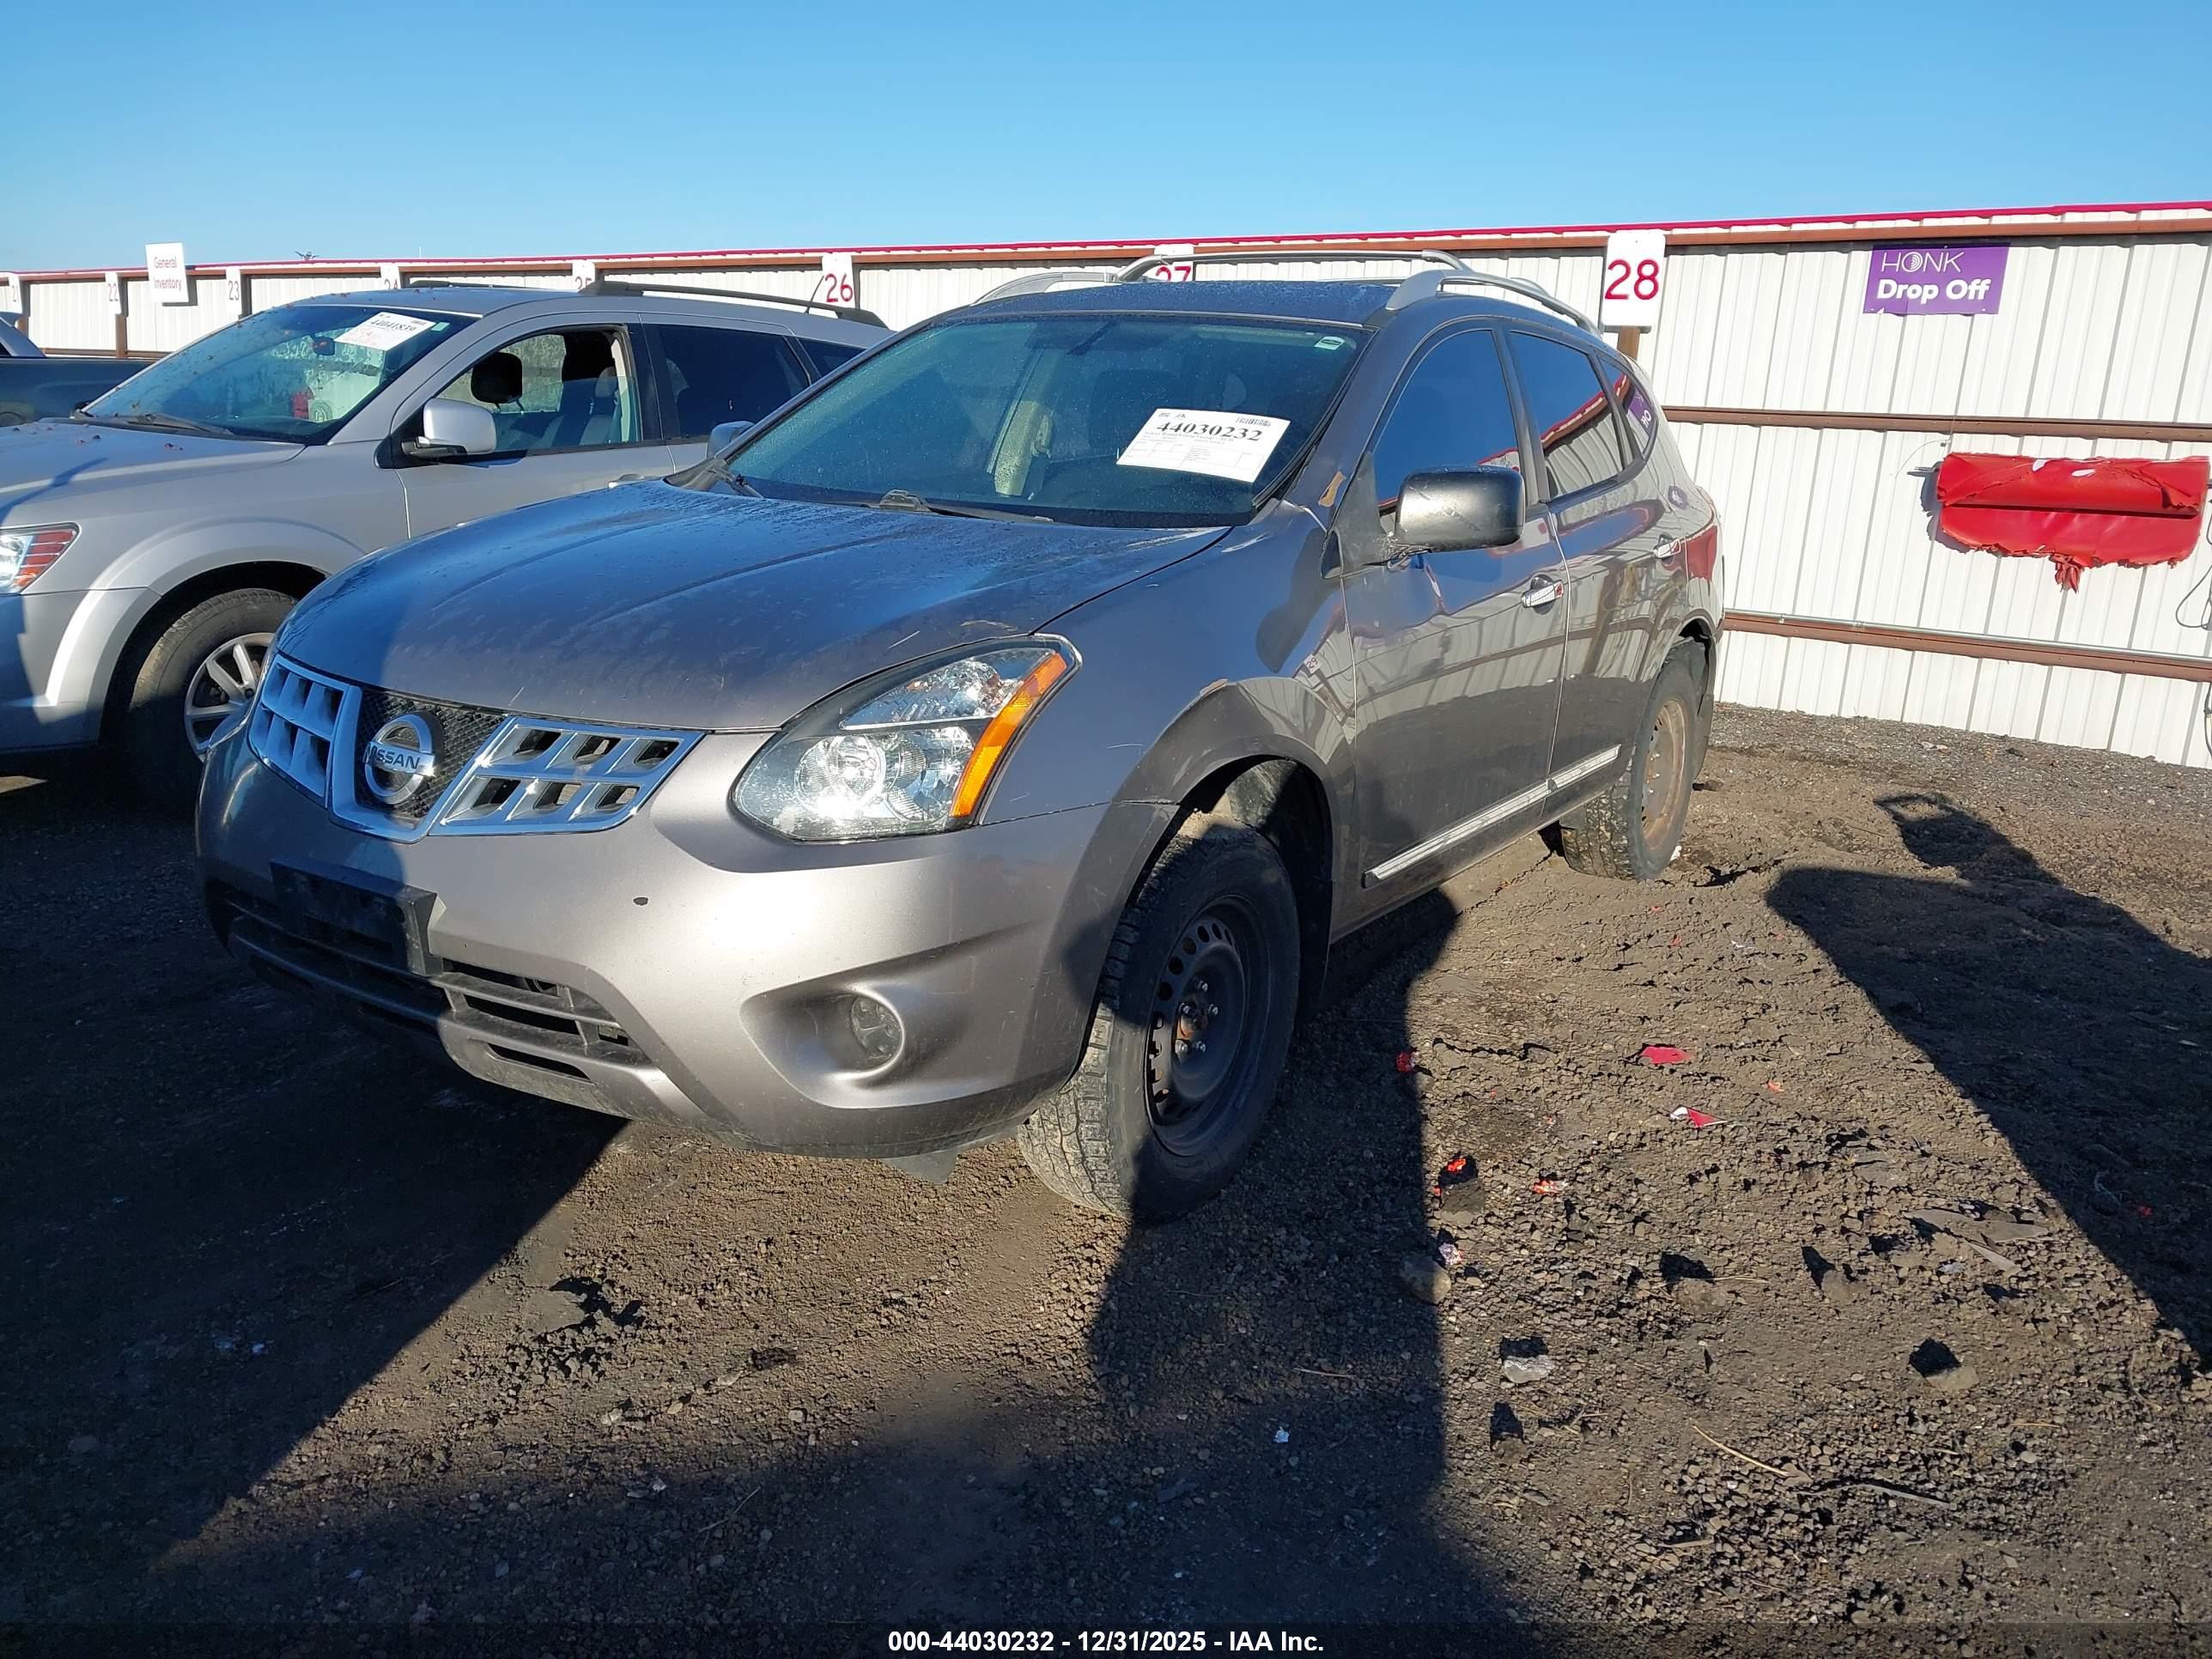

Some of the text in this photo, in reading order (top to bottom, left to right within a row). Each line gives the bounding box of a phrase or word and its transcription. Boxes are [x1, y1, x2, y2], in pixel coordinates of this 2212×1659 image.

[154, 255, 178, 269] General
[1881, 251, 1965, 273] HONK
[153, 276, 182, 291] Inventory
[228, 280, 240, 301] 23
[824, 273, 854, 302] 26
[1605, 259, 1659, 301] 28
[107, 283, 119, 302] 22
[1876, 278, 1992, 304] Drop Off
[1156, 421, 1263, 441] 44030232
[363, 743, 421, 770] NISSAN
